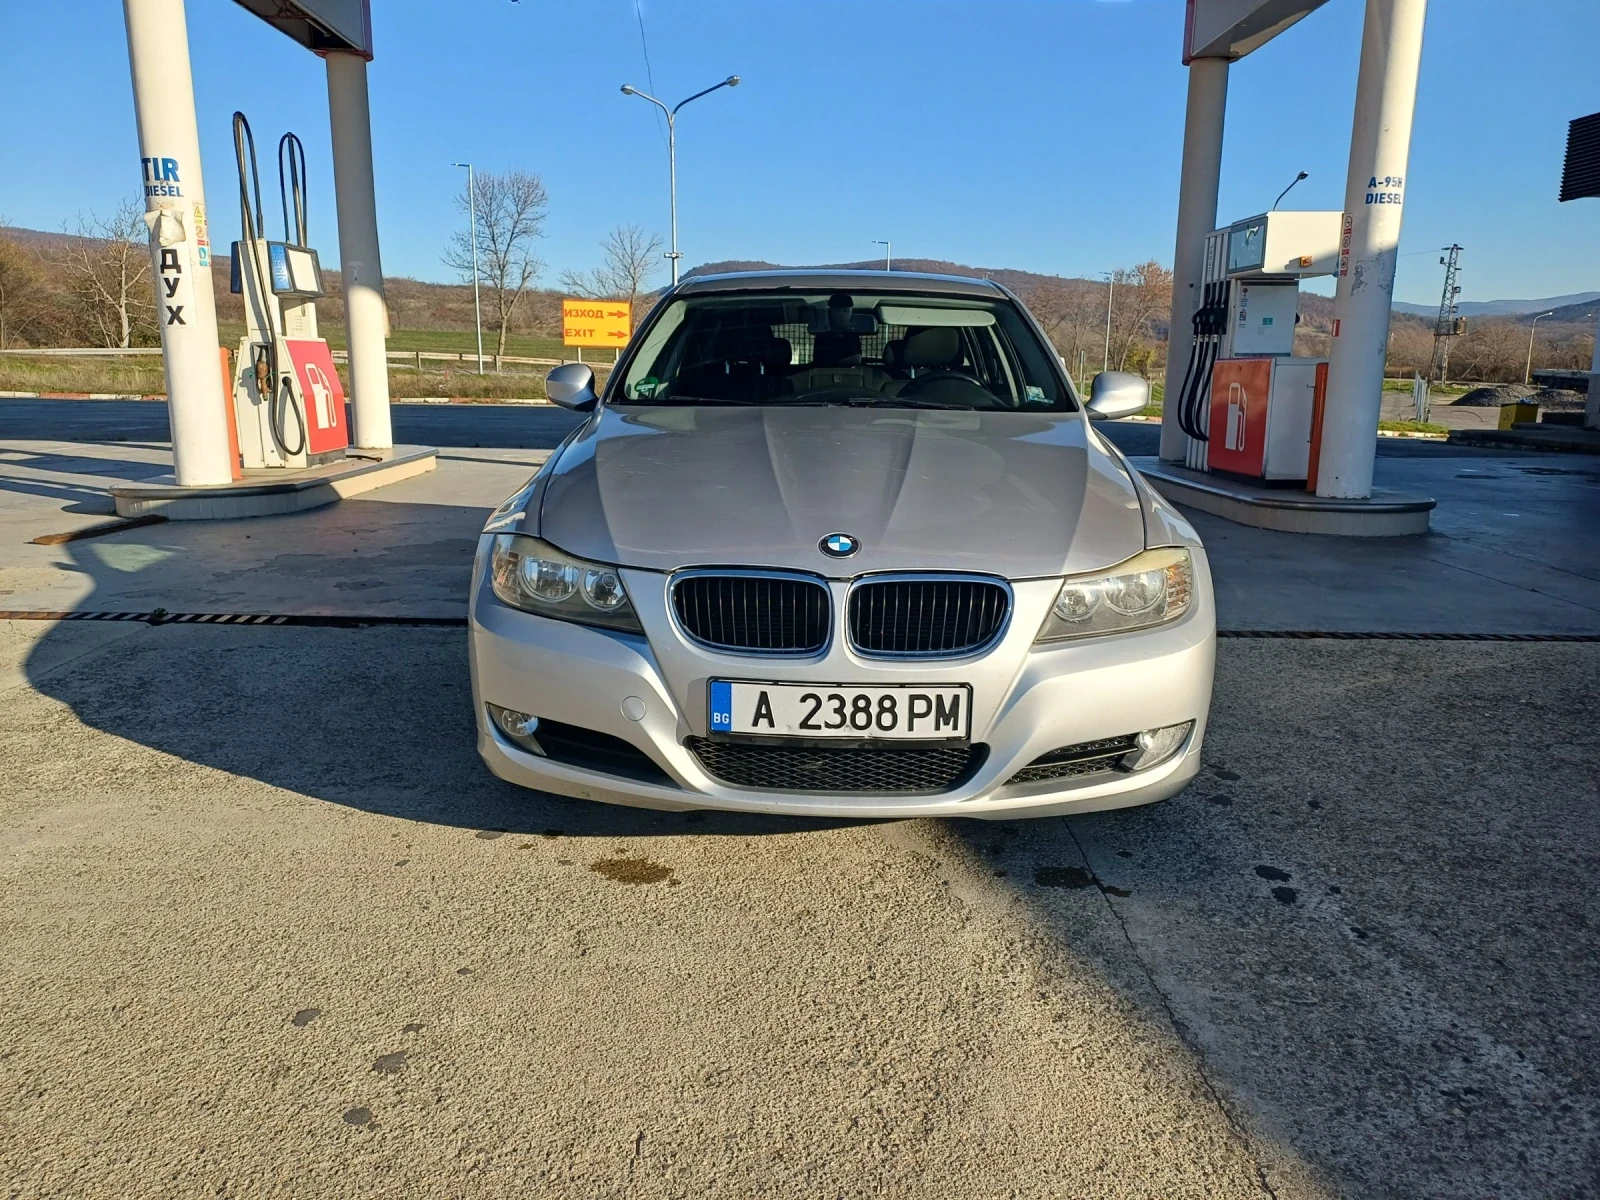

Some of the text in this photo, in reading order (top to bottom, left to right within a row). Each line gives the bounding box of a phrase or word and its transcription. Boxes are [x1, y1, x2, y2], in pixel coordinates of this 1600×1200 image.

[141, 157, 180, 182] TIR
[144, 185, 184, 197] DIESEL
[1365, 192, 1402, 205] DIESEL
[564, 308, 604, 319] ИЗХОД
[564, 328, 595, 338] EXIT
[751, 690, 960, 732] A 2388 PM
[713, 712, 730, 724] BG
